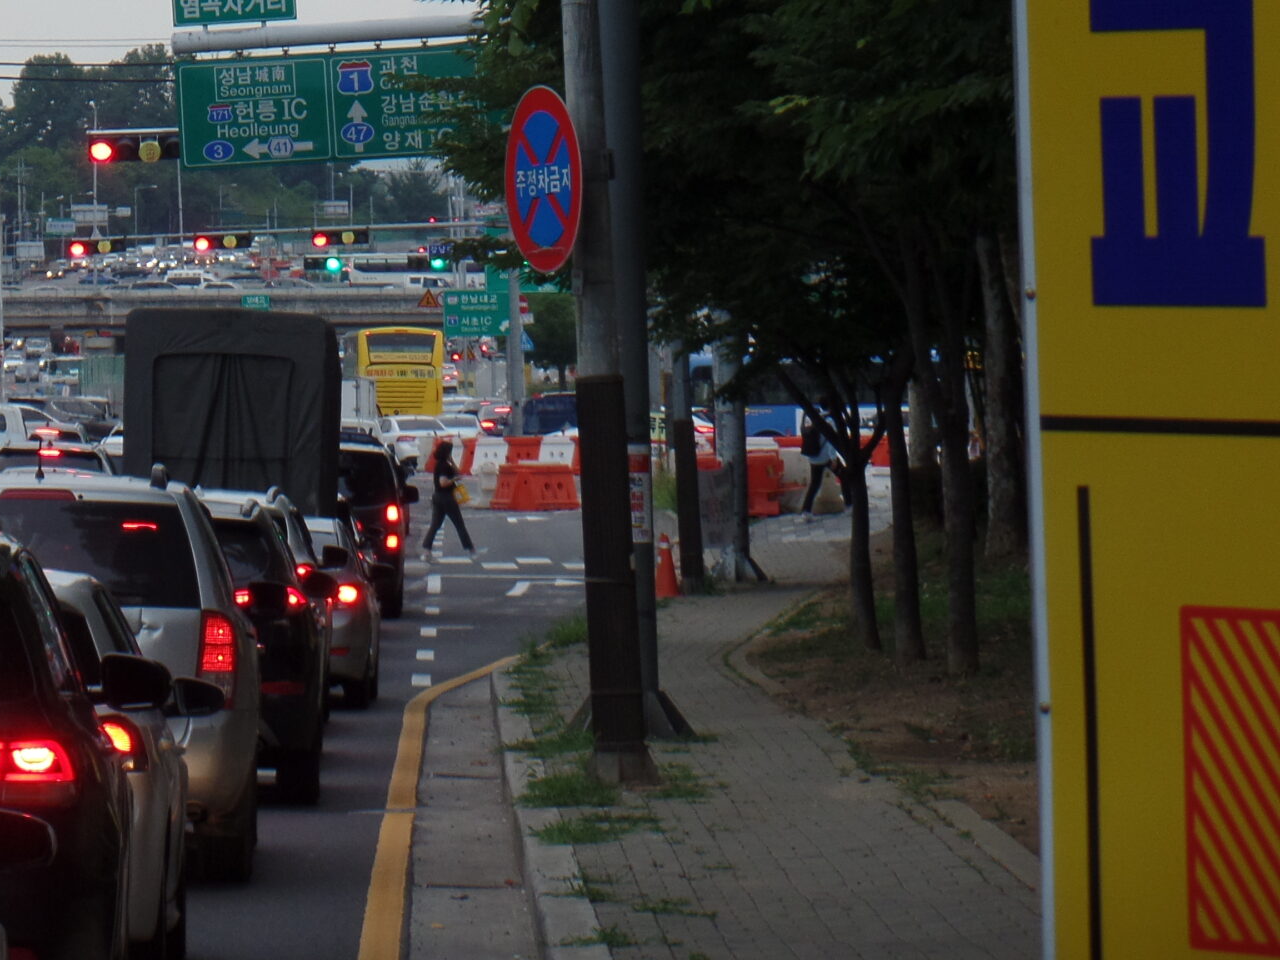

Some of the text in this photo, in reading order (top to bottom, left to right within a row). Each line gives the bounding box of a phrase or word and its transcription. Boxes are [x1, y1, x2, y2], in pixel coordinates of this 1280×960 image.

[379, 56, 418, 76] 과천
[220, 66, 252, 85] 성남
[349, 72, 359, 91] 1
[220, 84, 292, 98] Seongnam
[211, 109, 229, 121] 171
[217, 123, 299, 138] Heolleung
[347, 126, 367, 141] 47
[214, 145, 224, 159] 3
[273, 140, 289, 153] 41
[516, 163, 572, 198] 주정차금지
